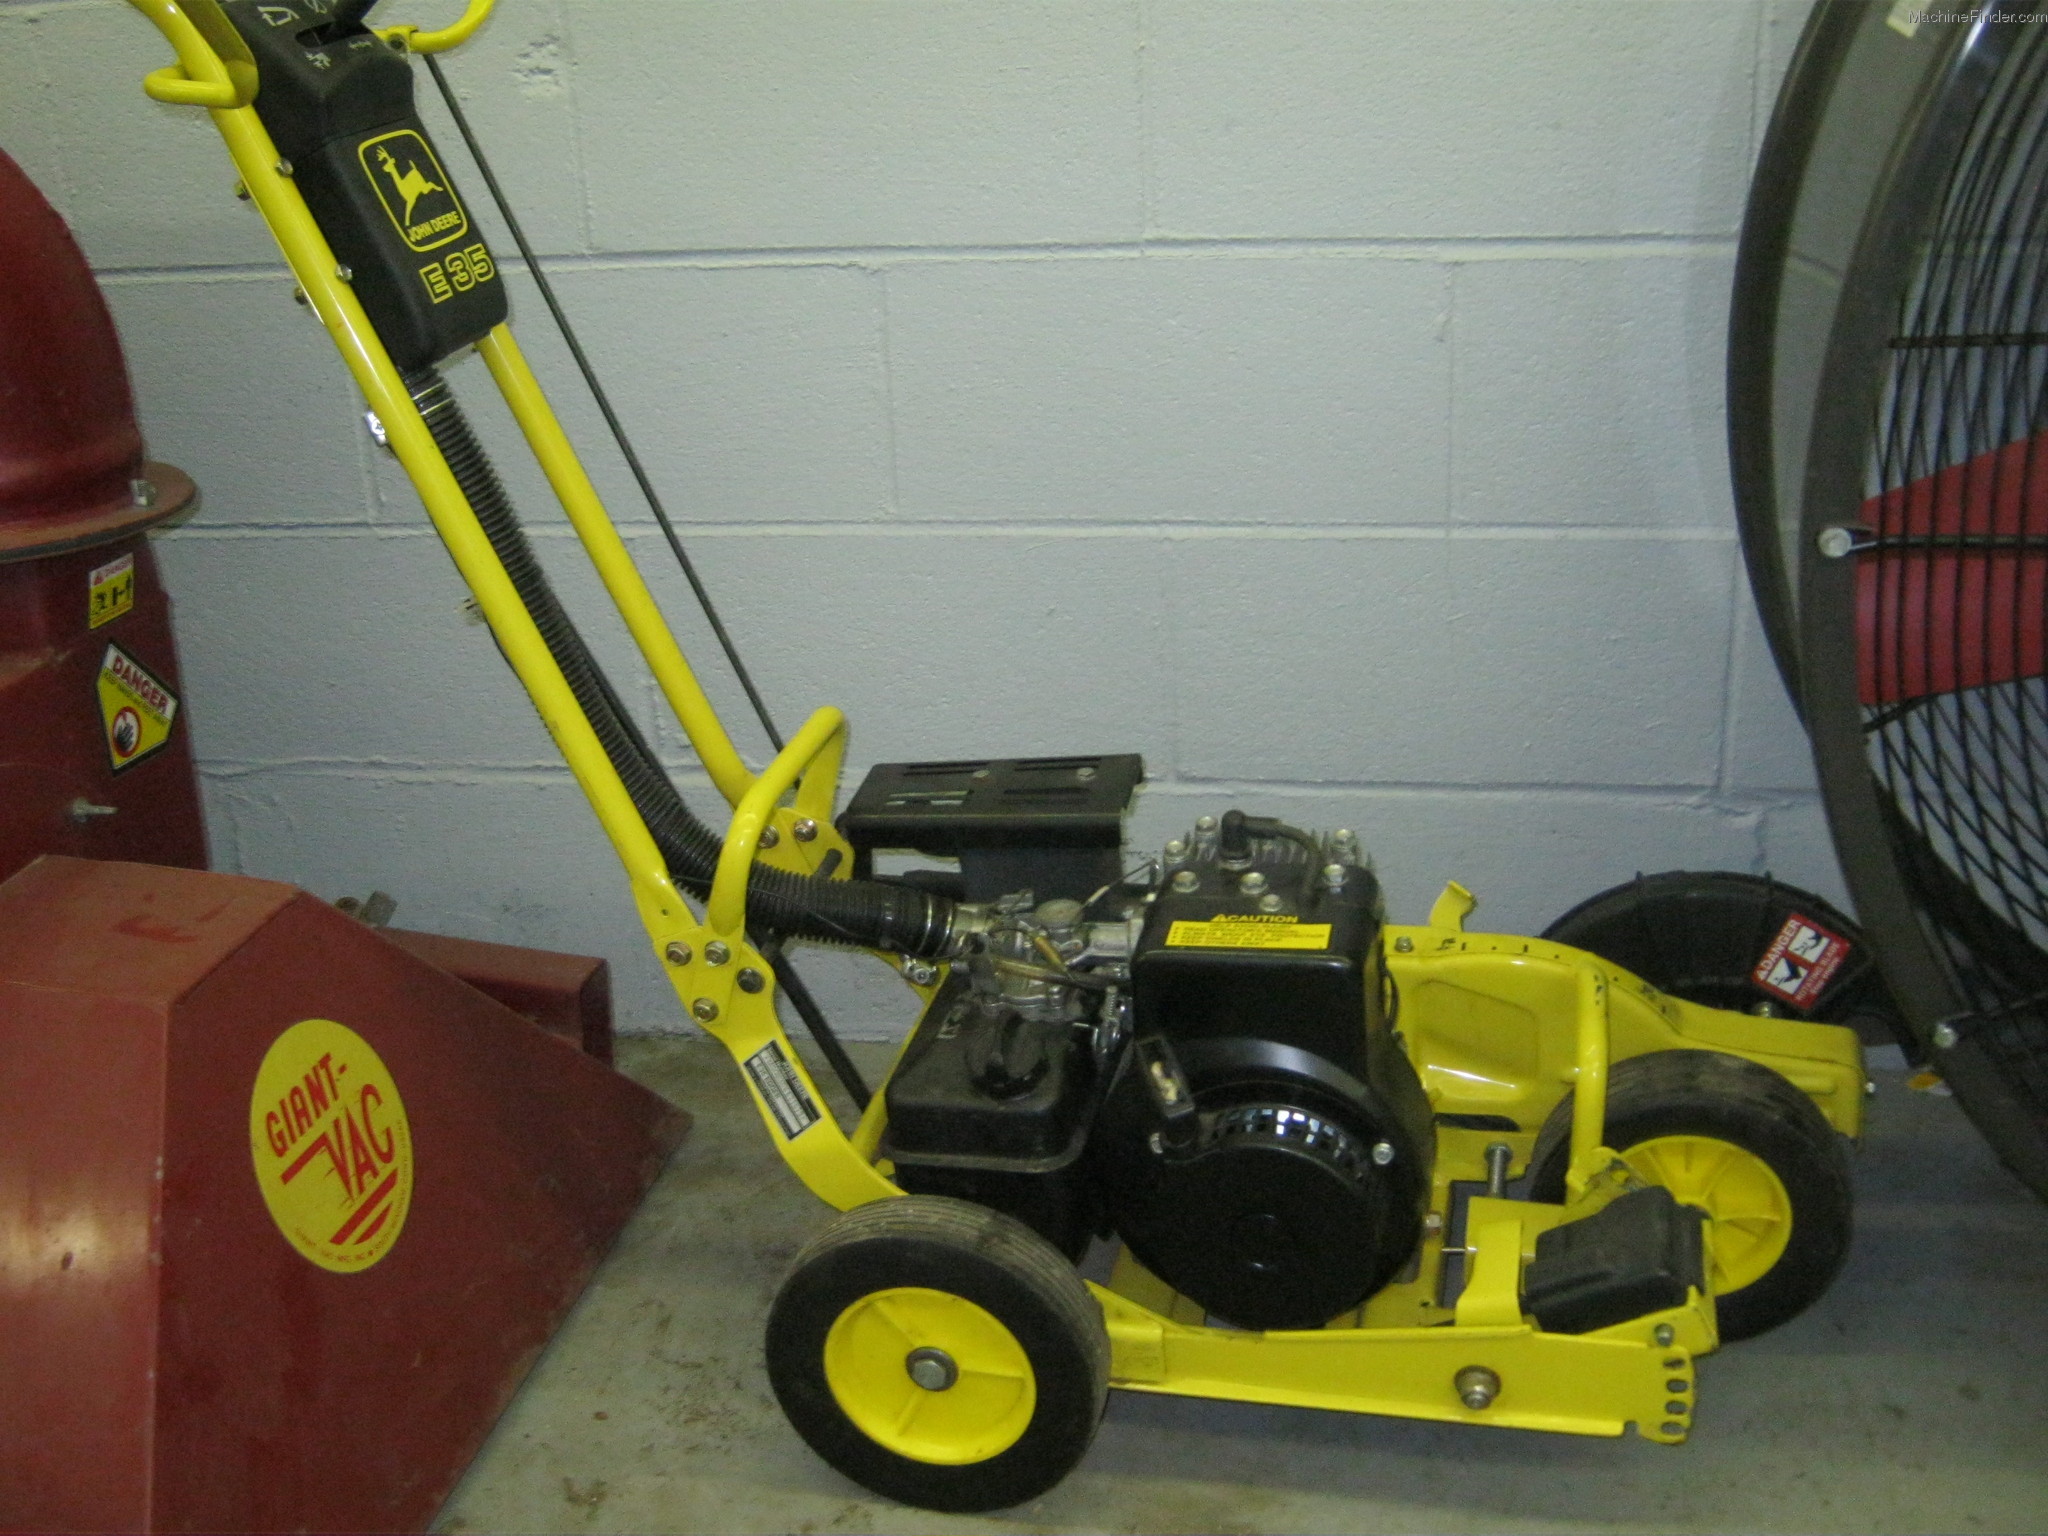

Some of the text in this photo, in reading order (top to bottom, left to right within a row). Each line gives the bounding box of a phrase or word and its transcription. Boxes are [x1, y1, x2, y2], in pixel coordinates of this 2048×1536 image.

[407, 210, 462, 243] JOHN DEERE
[112, 654, 170, 715] DANGER
[1230, 914, 1299, 924] CAUTION
[1760, 919, 1803, 971] DANGER
[1819, 942, 1841, 968] BLADE
[265, 1051, 348, 1158] GIANT-
[322, 1083, 396, 1201] VAC
